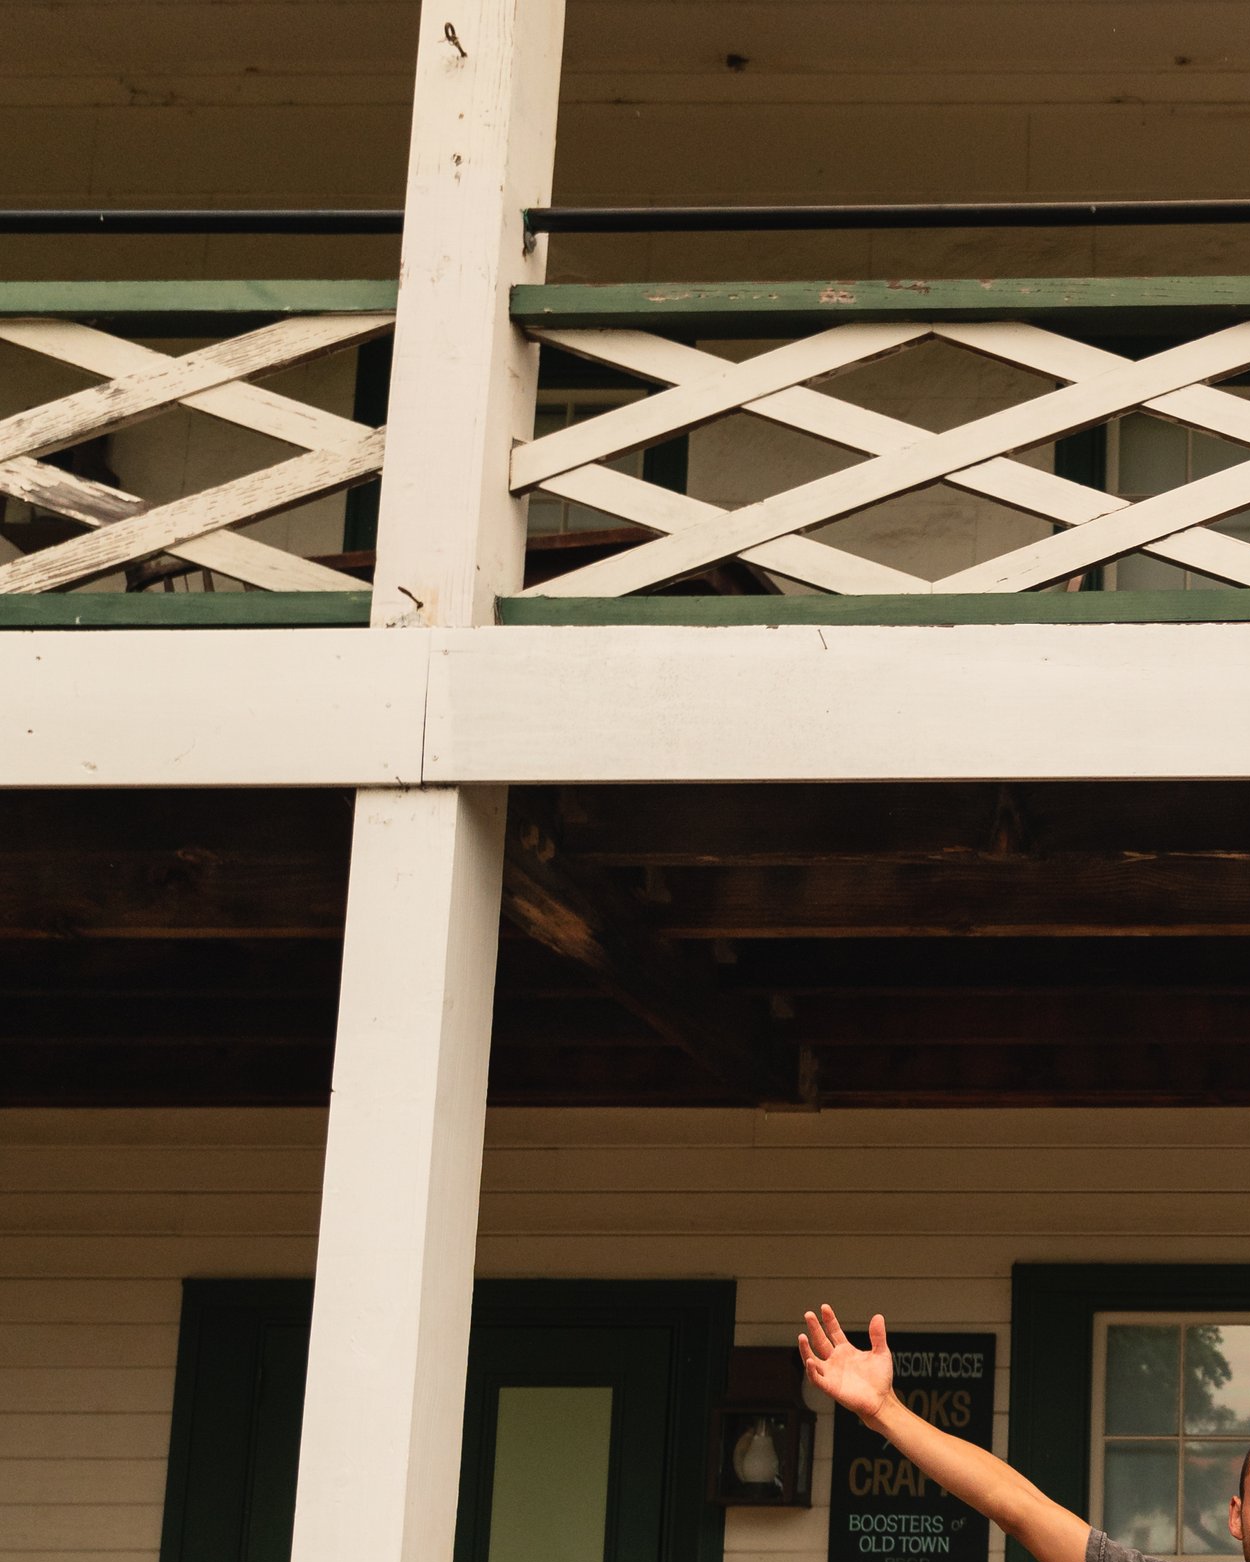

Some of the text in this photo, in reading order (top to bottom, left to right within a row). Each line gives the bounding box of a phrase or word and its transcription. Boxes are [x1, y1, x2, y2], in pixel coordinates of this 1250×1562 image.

[893, 1352, 934, 1377] NSON
[857, 1387, 972, 1428] OKS
[849, 1514, 944, 1533] BOOSTERS
[859, 1535, 950, 1553] OLD TOWN
